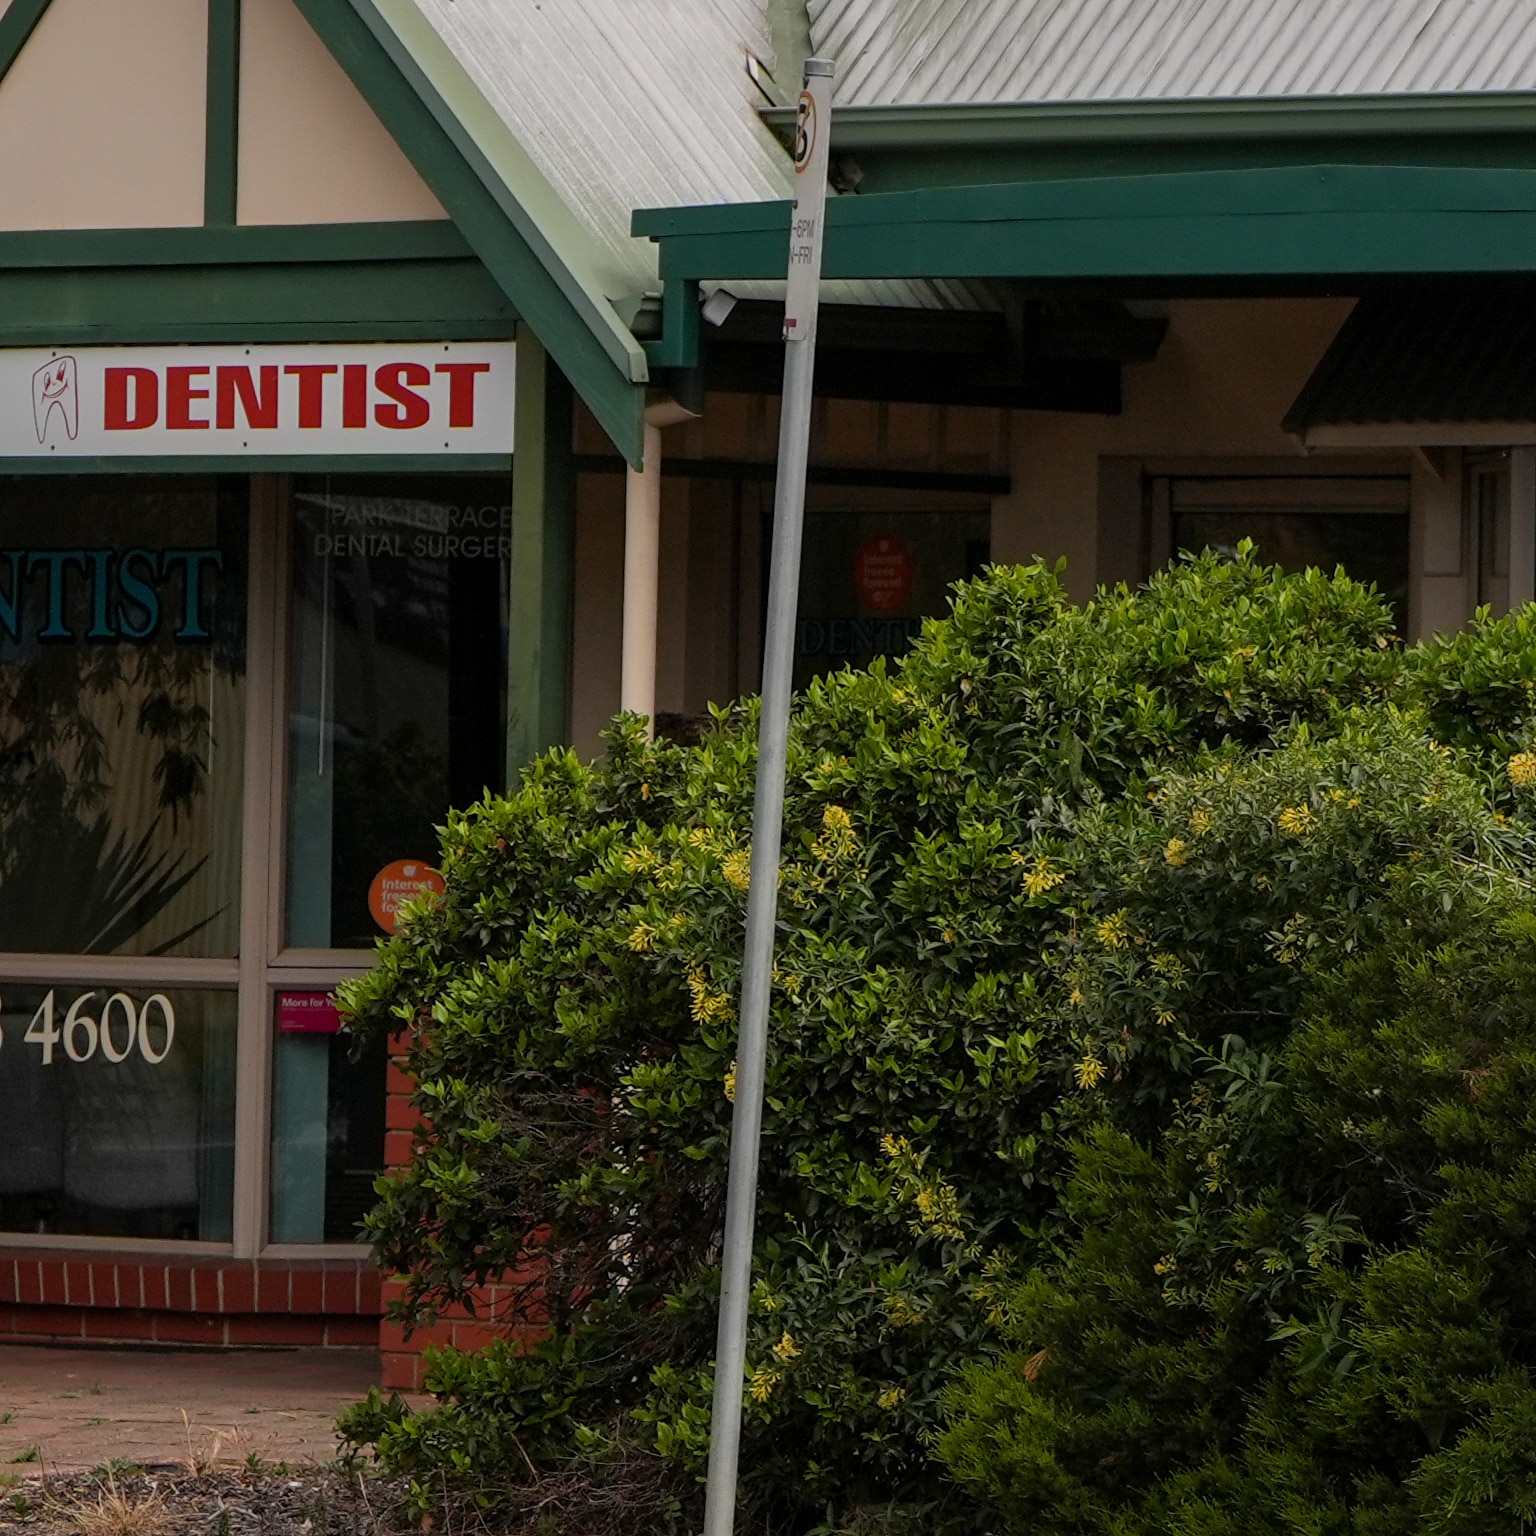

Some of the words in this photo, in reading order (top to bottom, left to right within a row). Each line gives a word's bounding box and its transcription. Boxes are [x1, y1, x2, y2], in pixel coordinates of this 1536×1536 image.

[103, 362, 491, 431] DENTIST
[330, 504, 393, 526] PARK
[314, 533, 406, 558] DENTAL
[281, 997, 308, 1007] More
[309, 997, 325, 1007] for
[24, 989, 175, 1065] 4600
